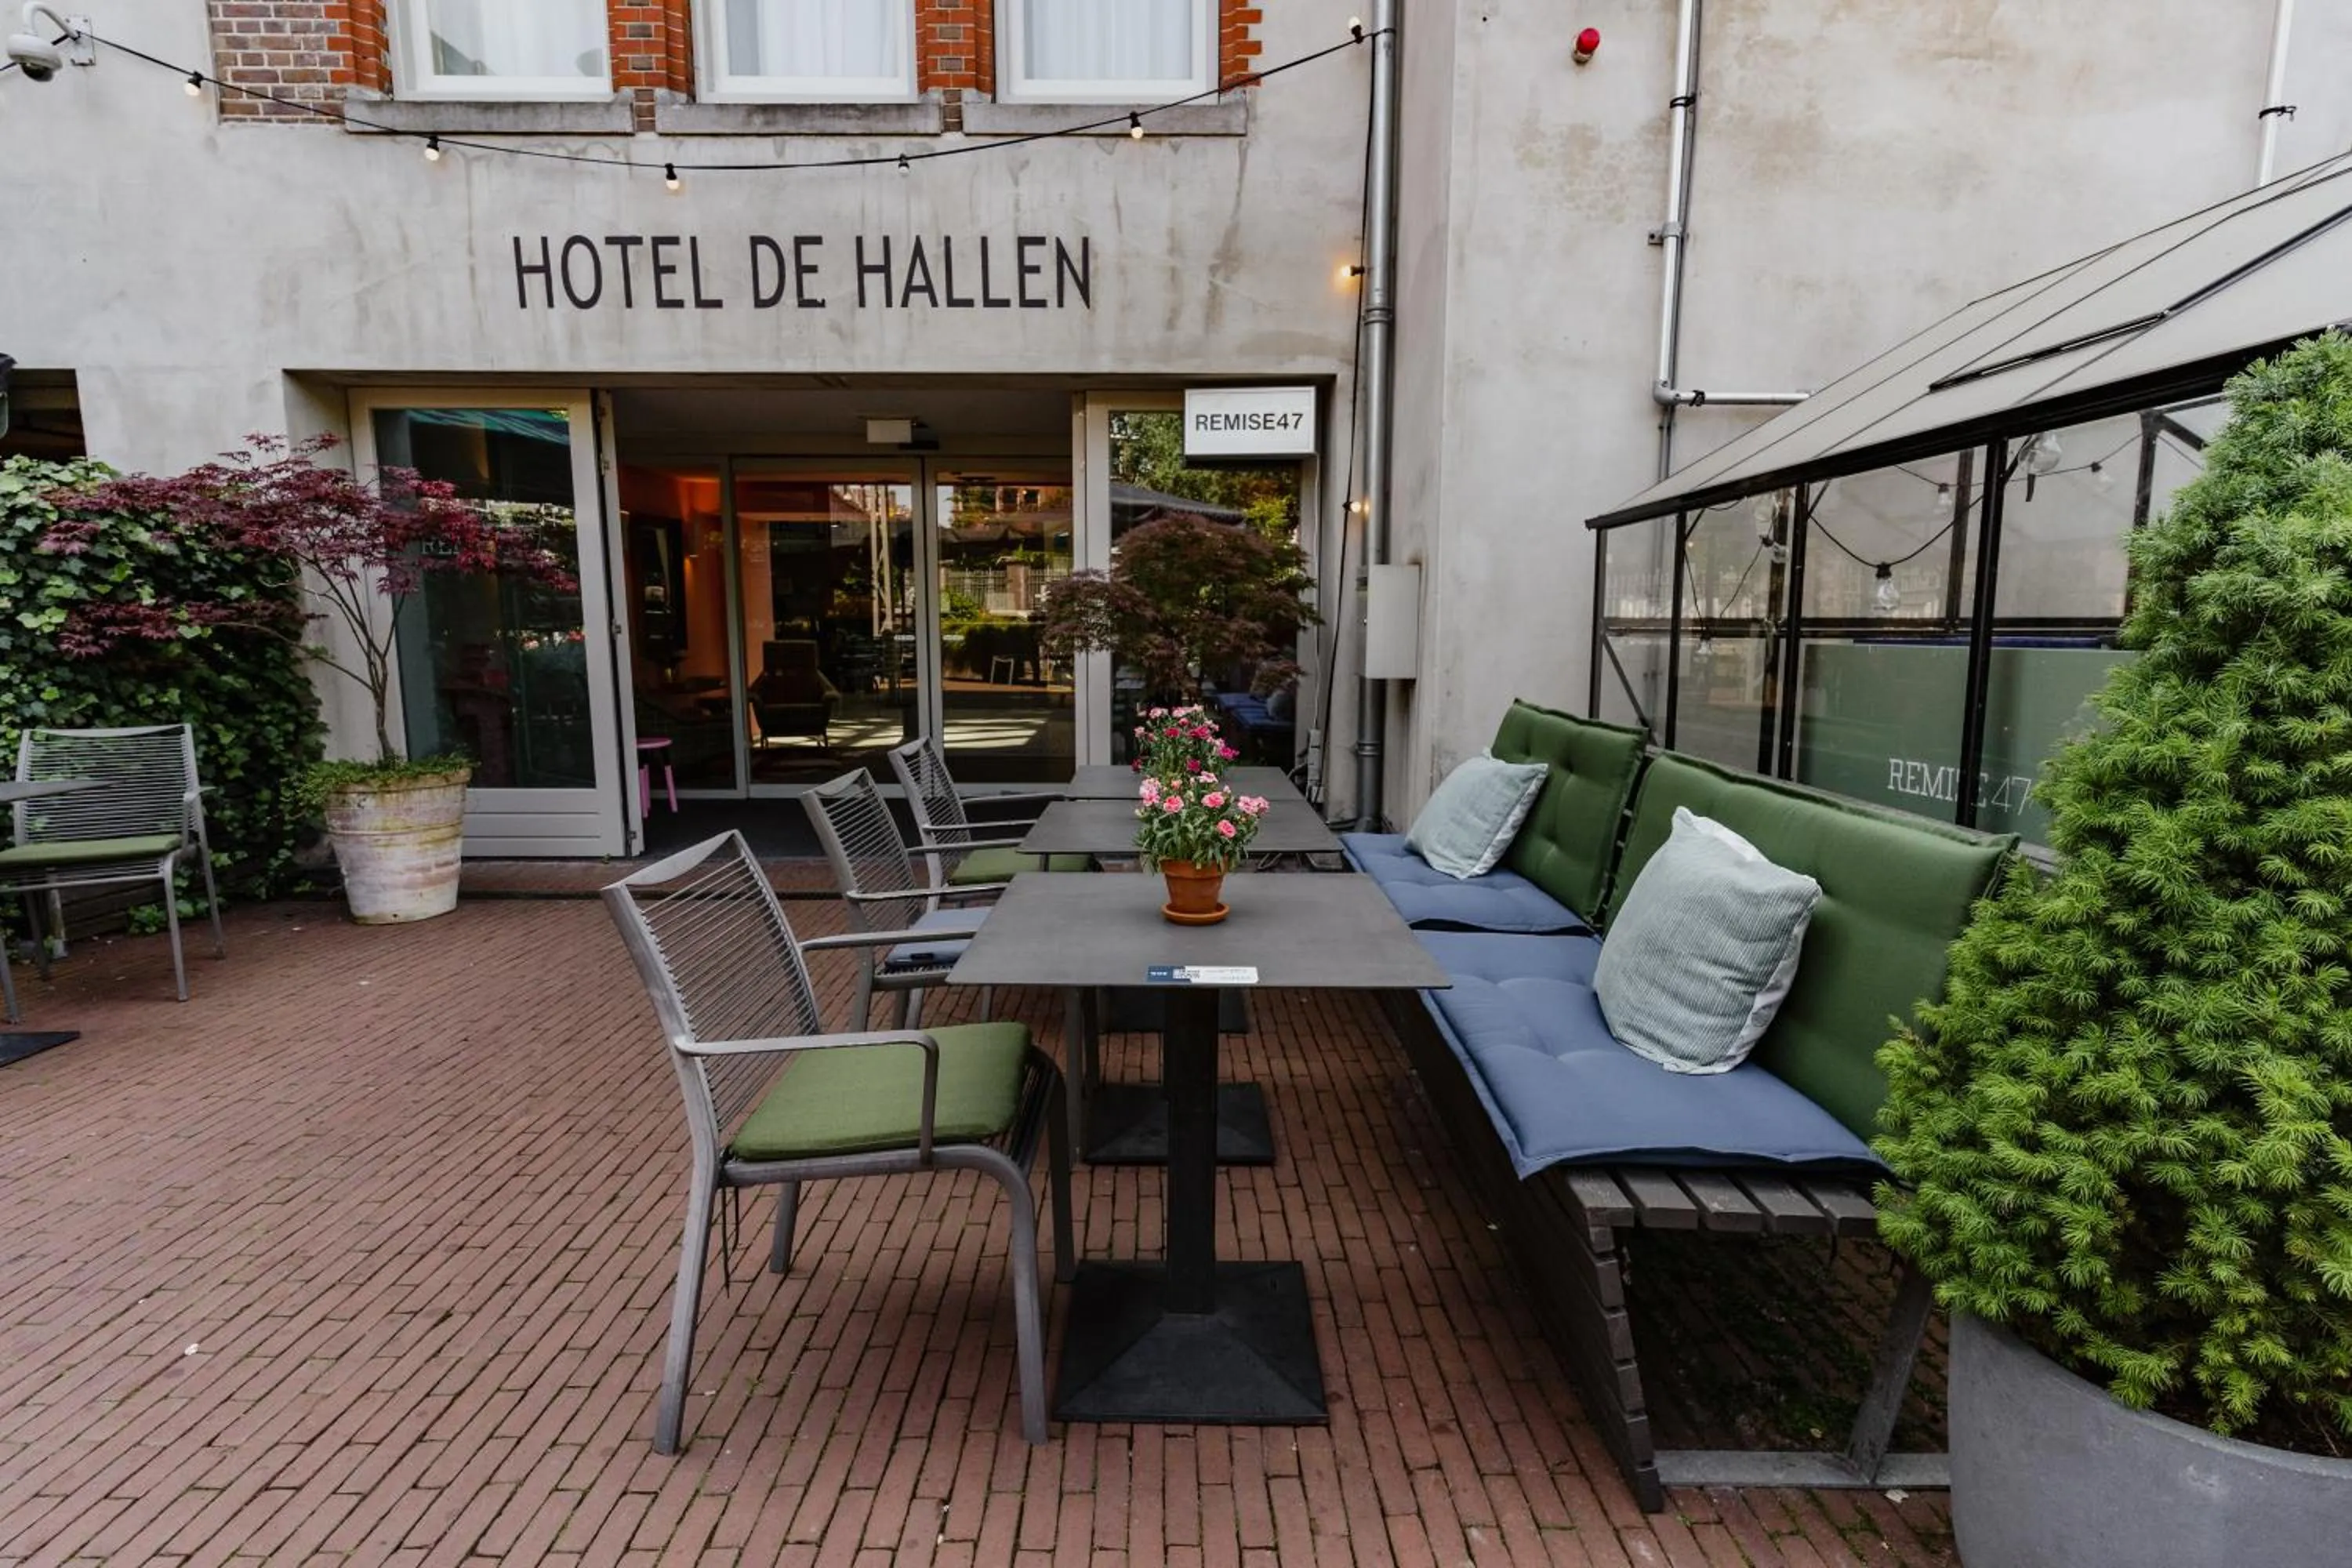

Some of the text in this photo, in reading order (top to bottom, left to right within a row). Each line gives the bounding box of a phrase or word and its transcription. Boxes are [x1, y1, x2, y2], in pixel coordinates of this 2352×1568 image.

[513, 234, 1091, 310] HOTEL DE HALLEN
[1195, 412, 1304, 431] REMISE47
